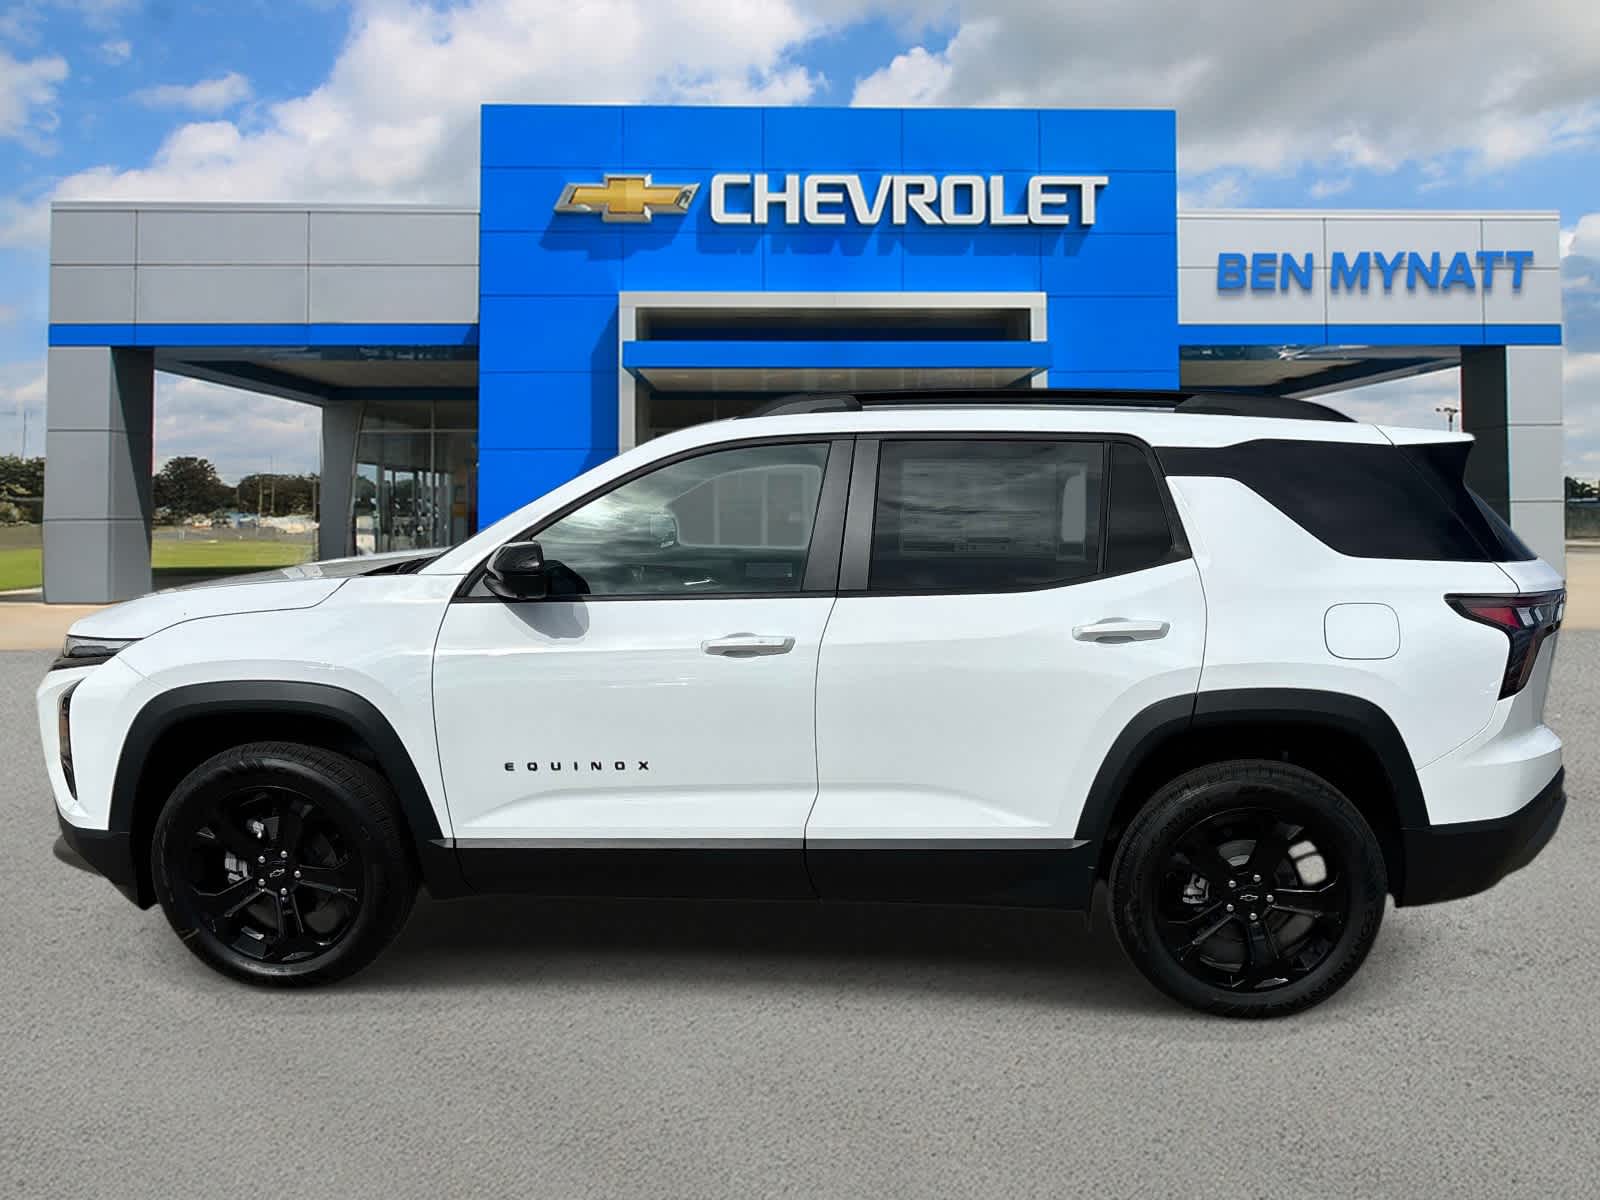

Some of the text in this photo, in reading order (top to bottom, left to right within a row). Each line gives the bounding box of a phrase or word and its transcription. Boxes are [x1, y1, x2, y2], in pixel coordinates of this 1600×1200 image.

[710, 173, 1109, 226] CHEVROLET
[1217, 250, 1534, 291] BEN MYNATT
[504, 761, 649, 771] EQUINOX
